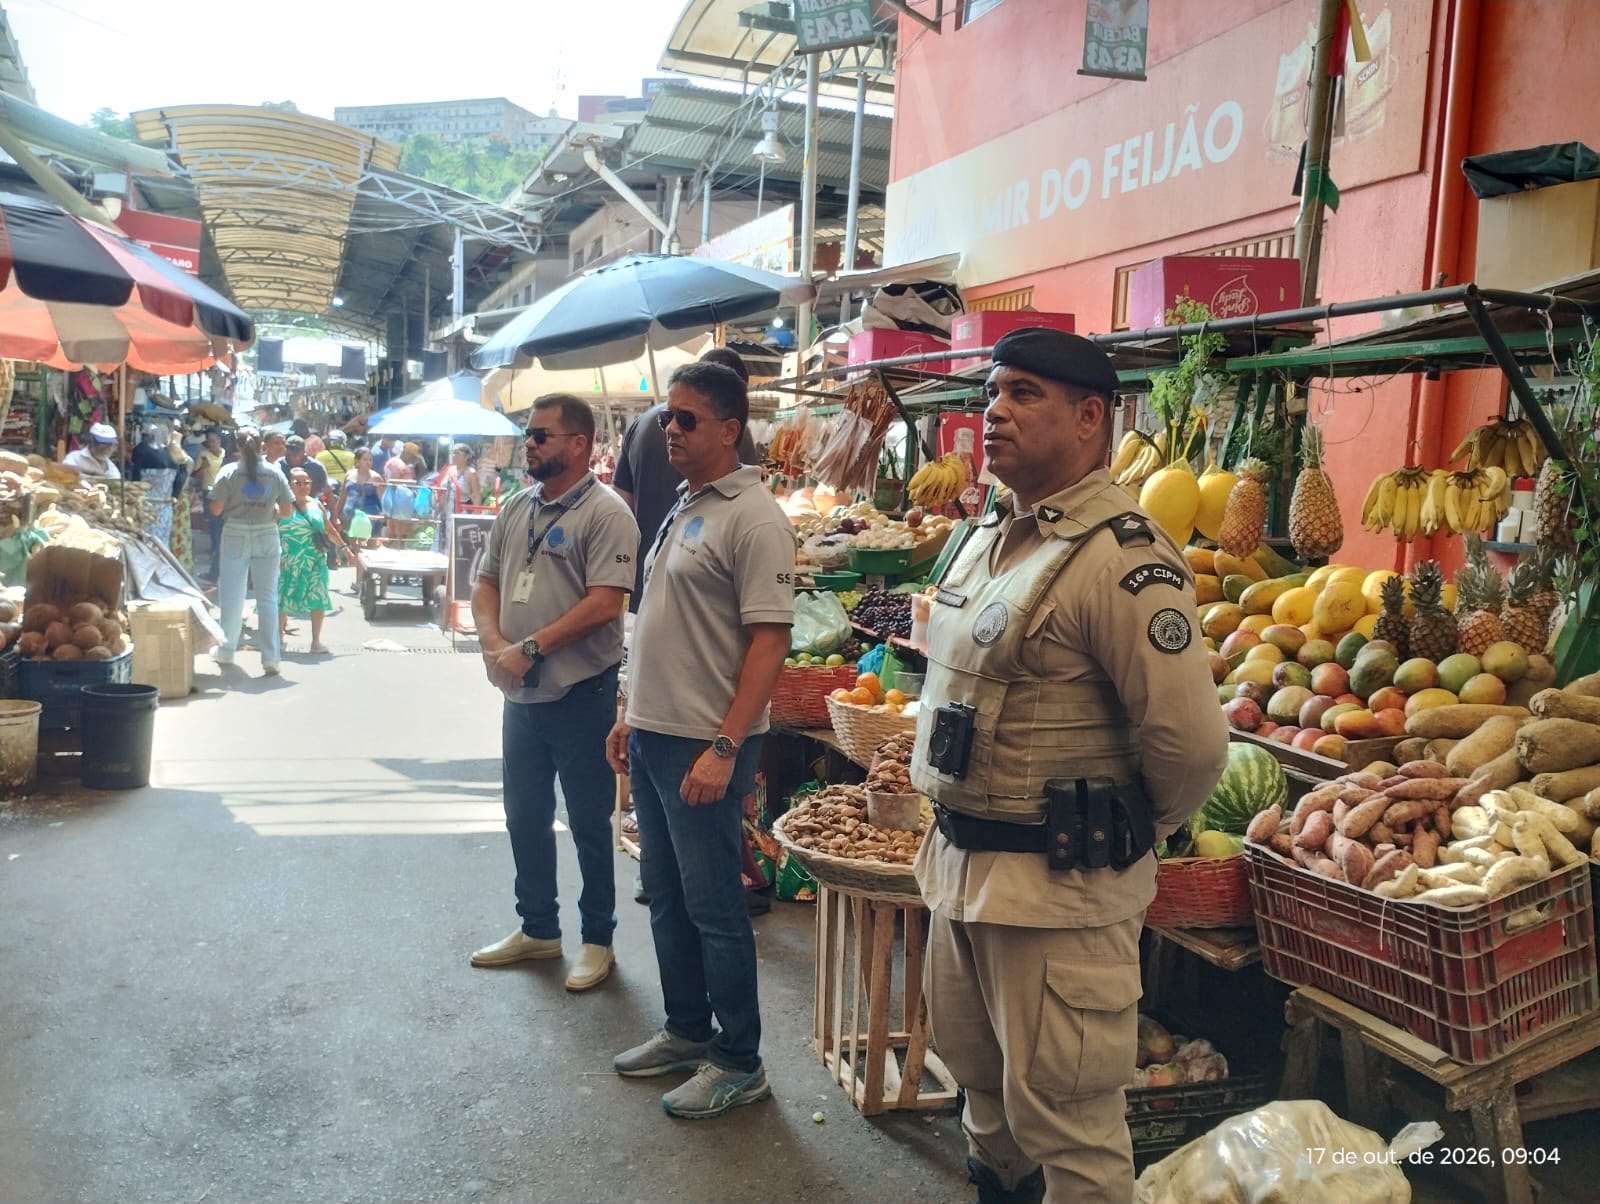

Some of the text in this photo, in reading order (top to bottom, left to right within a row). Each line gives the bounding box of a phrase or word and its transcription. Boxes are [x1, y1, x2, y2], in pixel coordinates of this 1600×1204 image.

[1040, 157, 1092, 220] DO
[1101, 100, 1244, 200] FEIJÃO
[1153, 568, 1181, 585] CIPM
